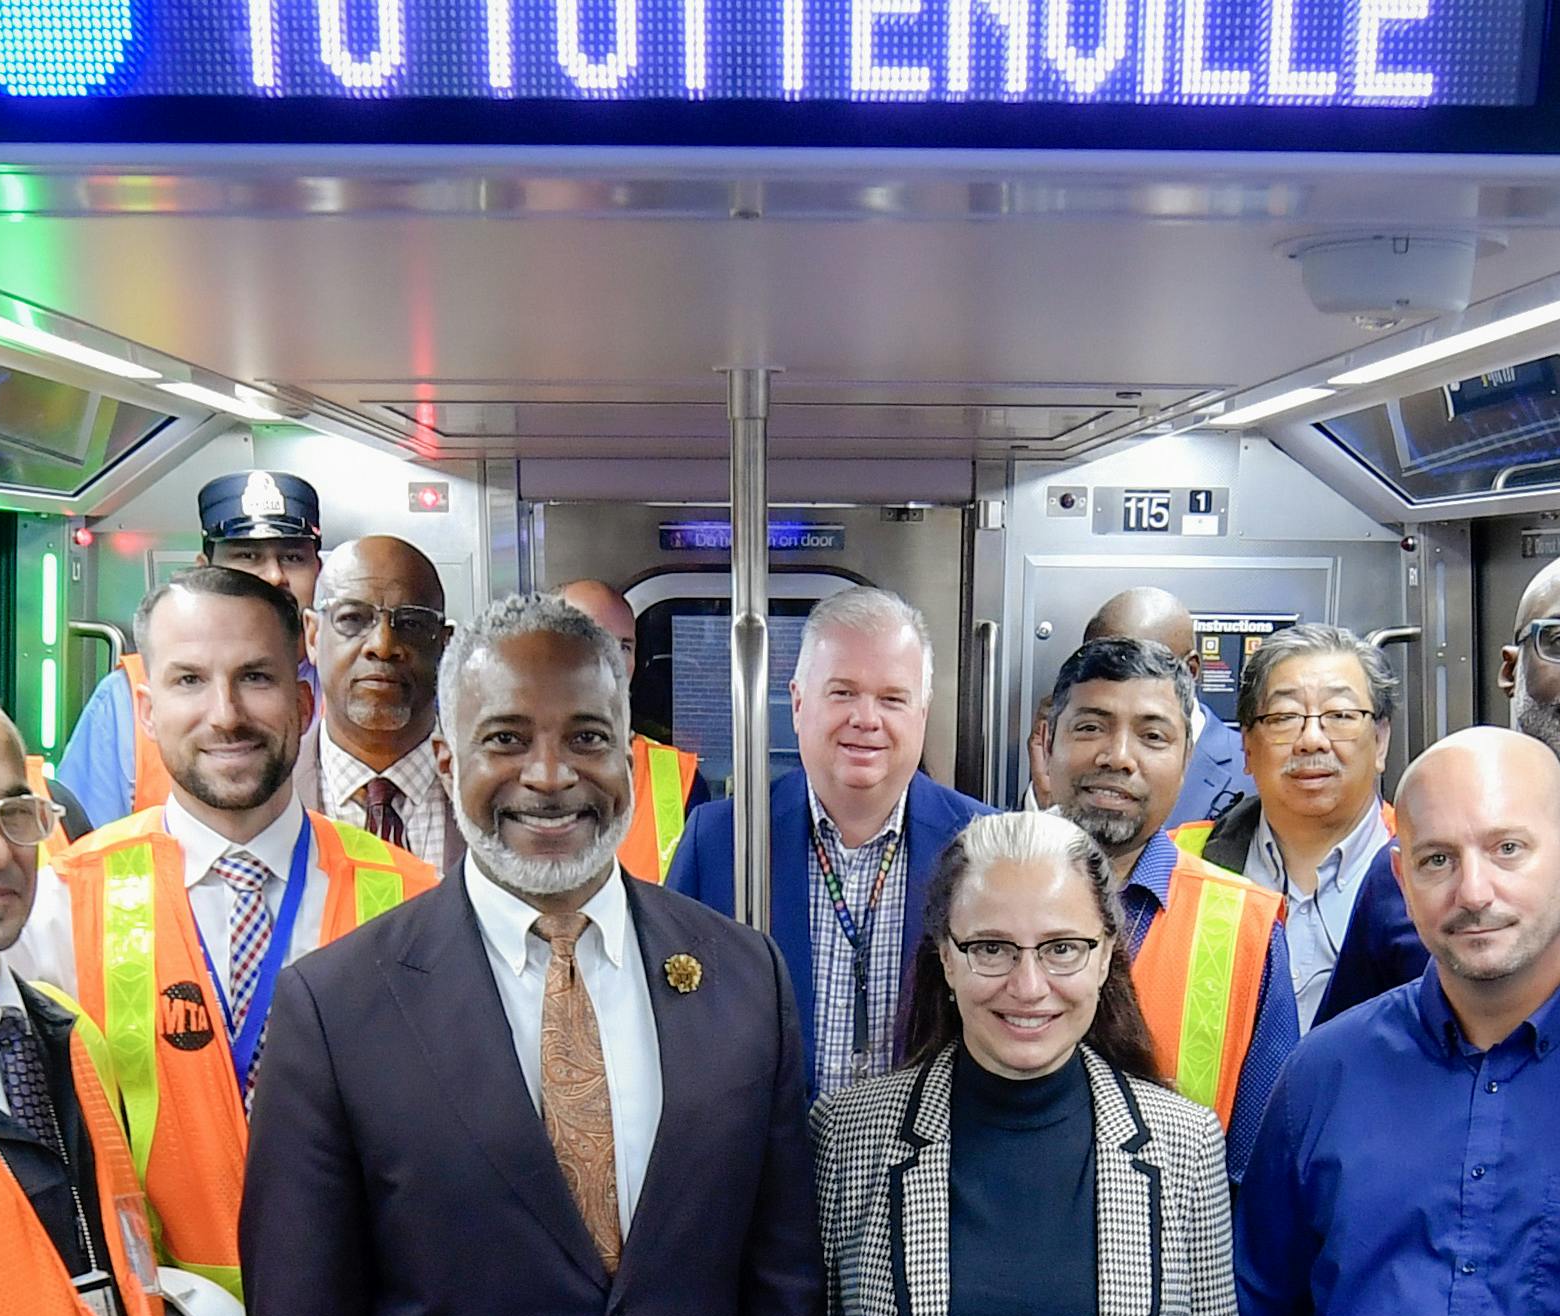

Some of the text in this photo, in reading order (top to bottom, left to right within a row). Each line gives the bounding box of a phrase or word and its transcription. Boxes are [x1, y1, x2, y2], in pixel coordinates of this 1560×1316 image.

[1195, 491, 1207, 512] 1
[1124, 497, 1170, 528] 115
[778, 535, 798, 547] on
[800, 532, 835, 547] door
[1193, 619, 1274, 633] Instructions
[161, 993, 211, 1039] MTA
